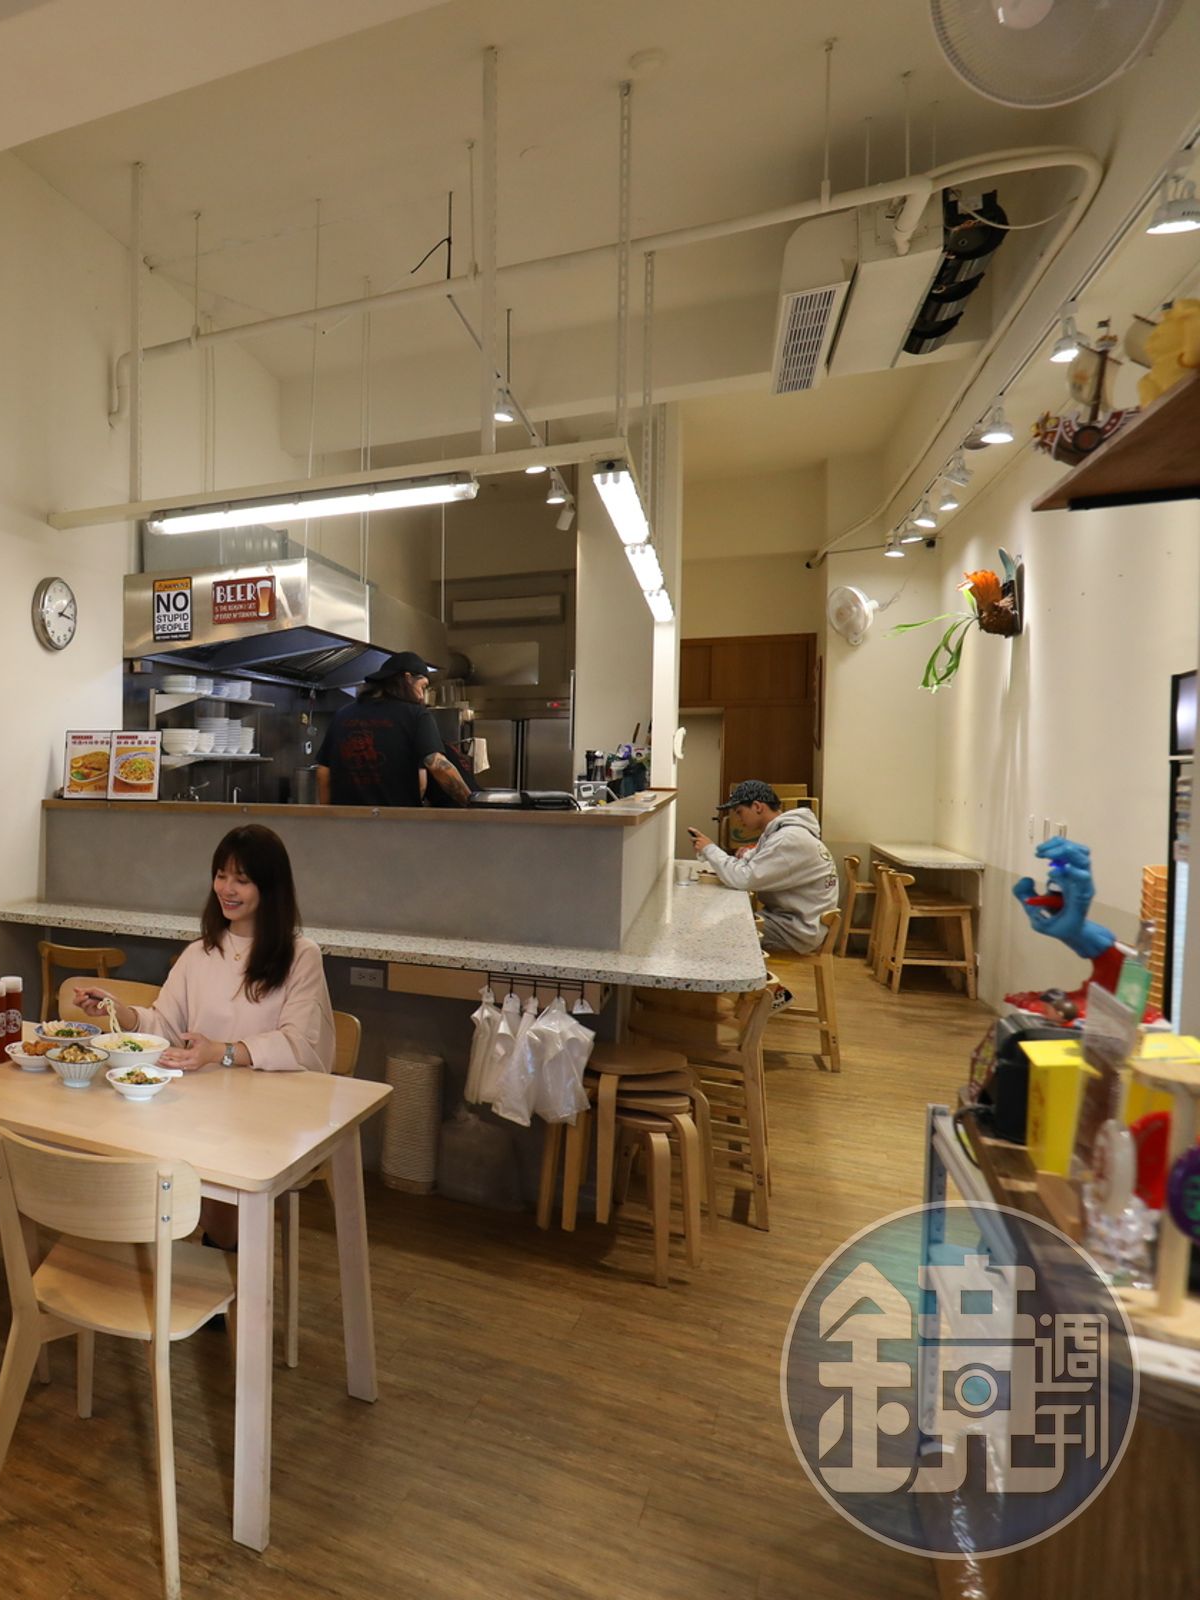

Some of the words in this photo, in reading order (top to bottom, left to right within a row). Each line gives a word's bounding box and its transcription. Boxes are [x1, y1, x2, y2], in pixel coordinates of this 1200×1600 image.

[216, 583, 257, 604] BEER
[156, 591, 189, 613] NO
[156, 612, 189, 623] STUPID
[156, 622, 189, 632] PEOPLE
